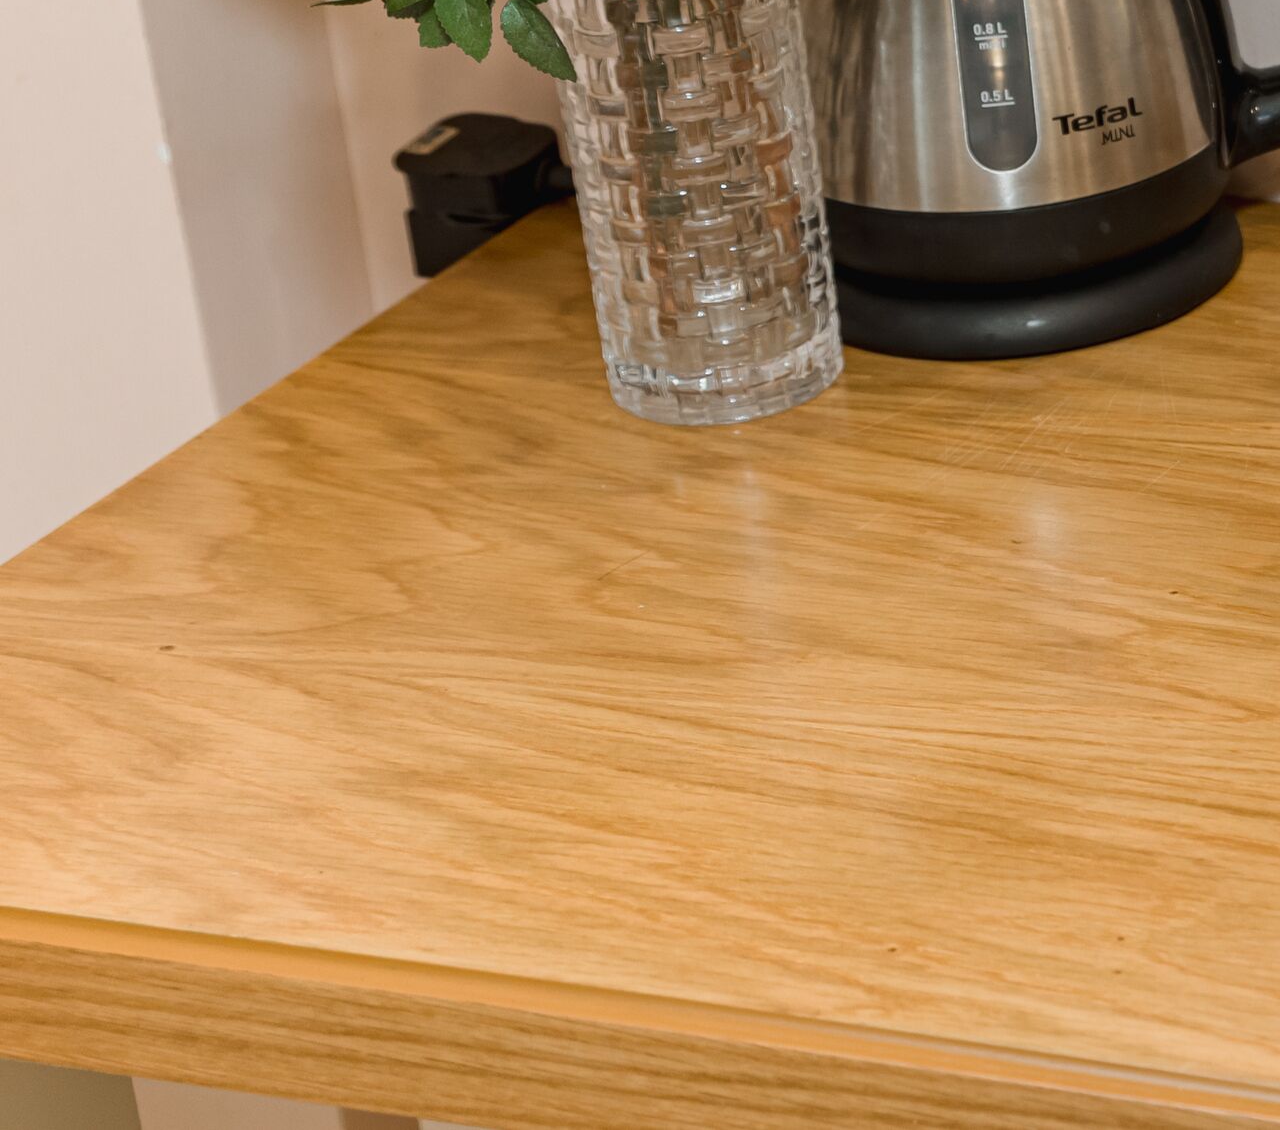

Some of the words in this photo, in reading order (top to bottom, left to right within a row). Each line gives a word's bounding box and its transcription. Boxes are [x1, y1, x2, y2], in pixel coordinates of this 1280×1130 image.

[973, 23, 994, 35] 0.8
[997, 21, 1008, 34] L
[980, 90, 1002, 103] 0.5
[1004, 89, 1015, 101] L
[1052, 96, 1143, 136] Tefal
[1101, 123, 1137, 146] MINI
